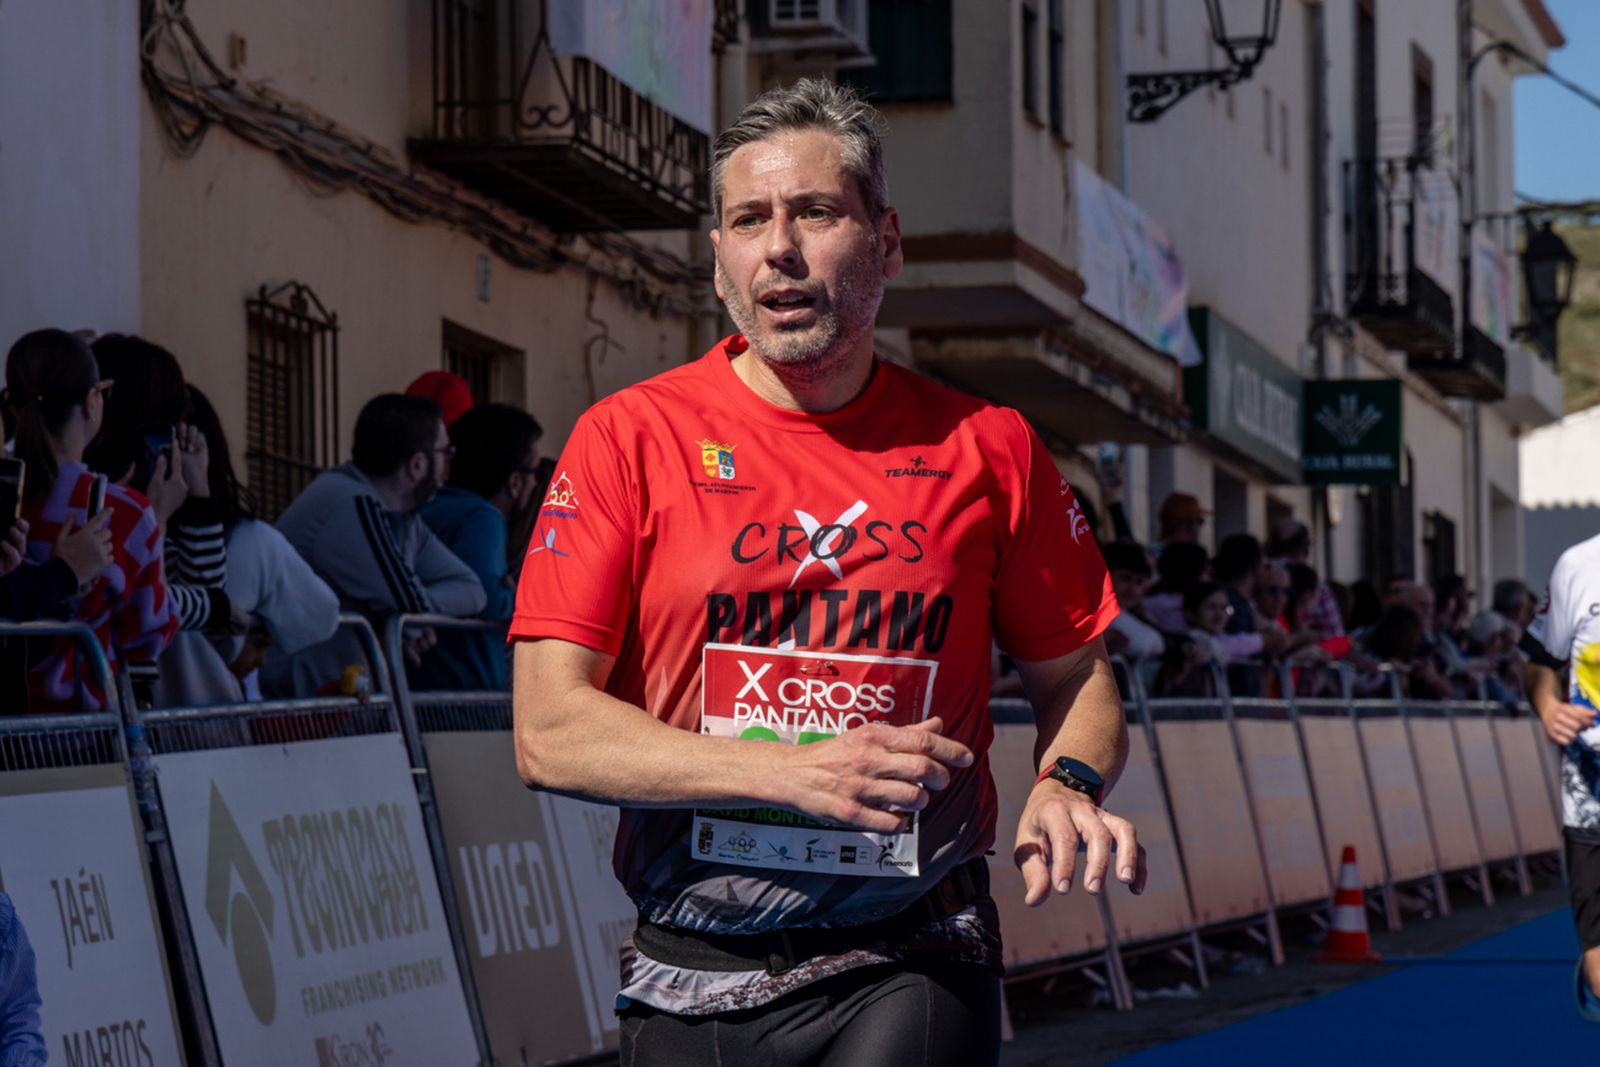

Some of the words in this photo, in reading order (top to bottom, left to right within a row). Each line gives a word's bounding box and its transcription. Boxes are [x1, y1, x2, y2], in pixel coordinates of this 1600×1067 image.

[884, 467, 953, 480] TEAMERGY
[1342, 453, 1393, 468] RURAL
[731, 520, 927, 566] CROSS
[706, 589, 953, 654] PANTANO
[736, 660, 773, 701] X
[778, 677, 896, 714] CROSS
[51, 866, 115, 970] JAÉN
[459, 840, 560, 957] UNED
[301, 970, 388, 1017] FRANCHISING
[388, 956, 448, 995] NETWORK
